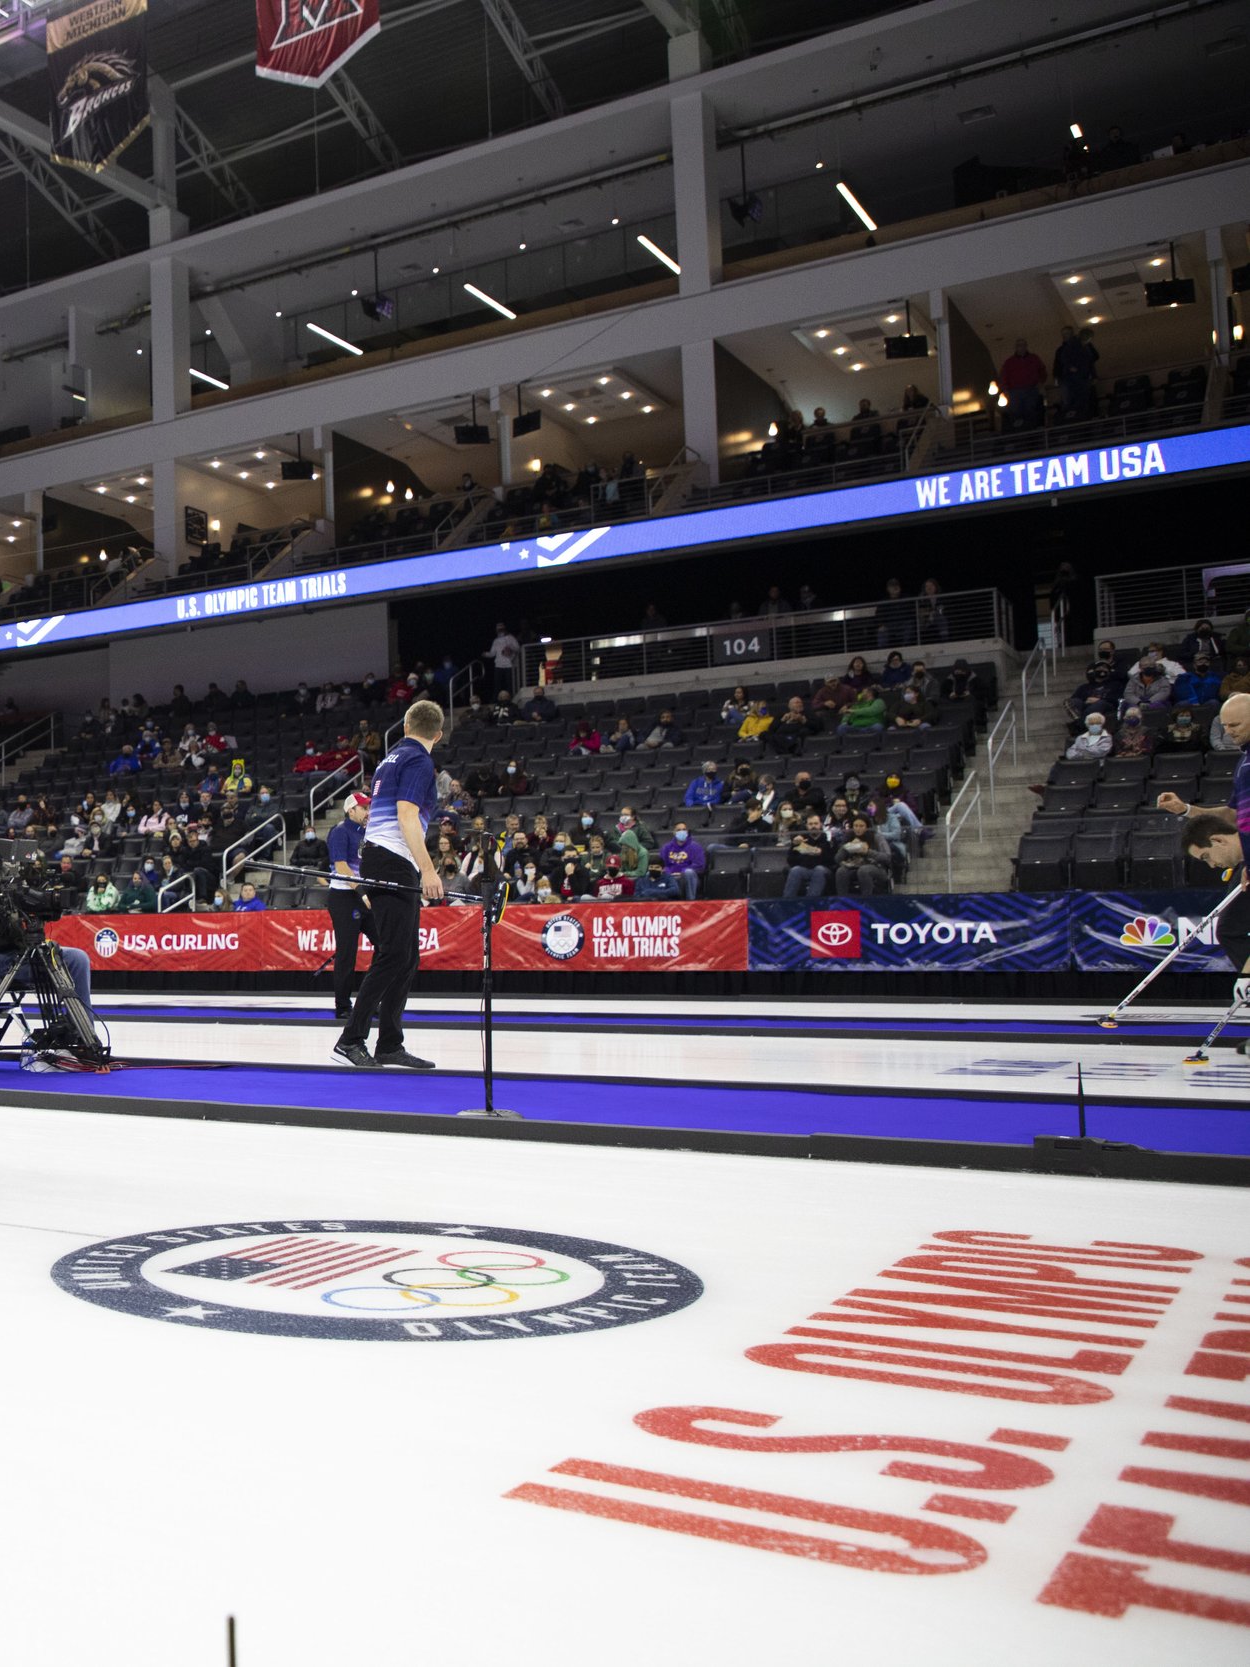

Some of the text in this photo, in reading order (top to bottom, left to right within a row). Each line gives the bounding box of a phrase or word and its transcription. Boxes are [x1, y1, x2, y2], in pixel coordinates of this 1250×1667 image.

[66, 7, 127, 40] MICHIGAN
[70, 0, 123, 27] WESTERN
[915, 442, 1166, 508] WE ARE TEAM USA
[176, 572, 347, 619] U.S. OLYMPIC TEAM TRIALS
[723, 636, 760, 656] 104
[297, 929, 320, 951] WE
[418, 928, 440, 951] SA
[592, 915, 682, 937] U.S. OLYMPIC
[870, 922, 998, 945] TOYOTA
[123, 933, 239, 951] USA CURLING
[592, 936, 680, 958] TEAM TRIALS
[71, 1222, 348, 1290] UNITED STATES
[399, 1252, 681, 1338] OLYMPIC TEAM
[743, 1229, 1206, 1406] OLYMPIC
[501, 1405, 1073, 1575] U.S.
